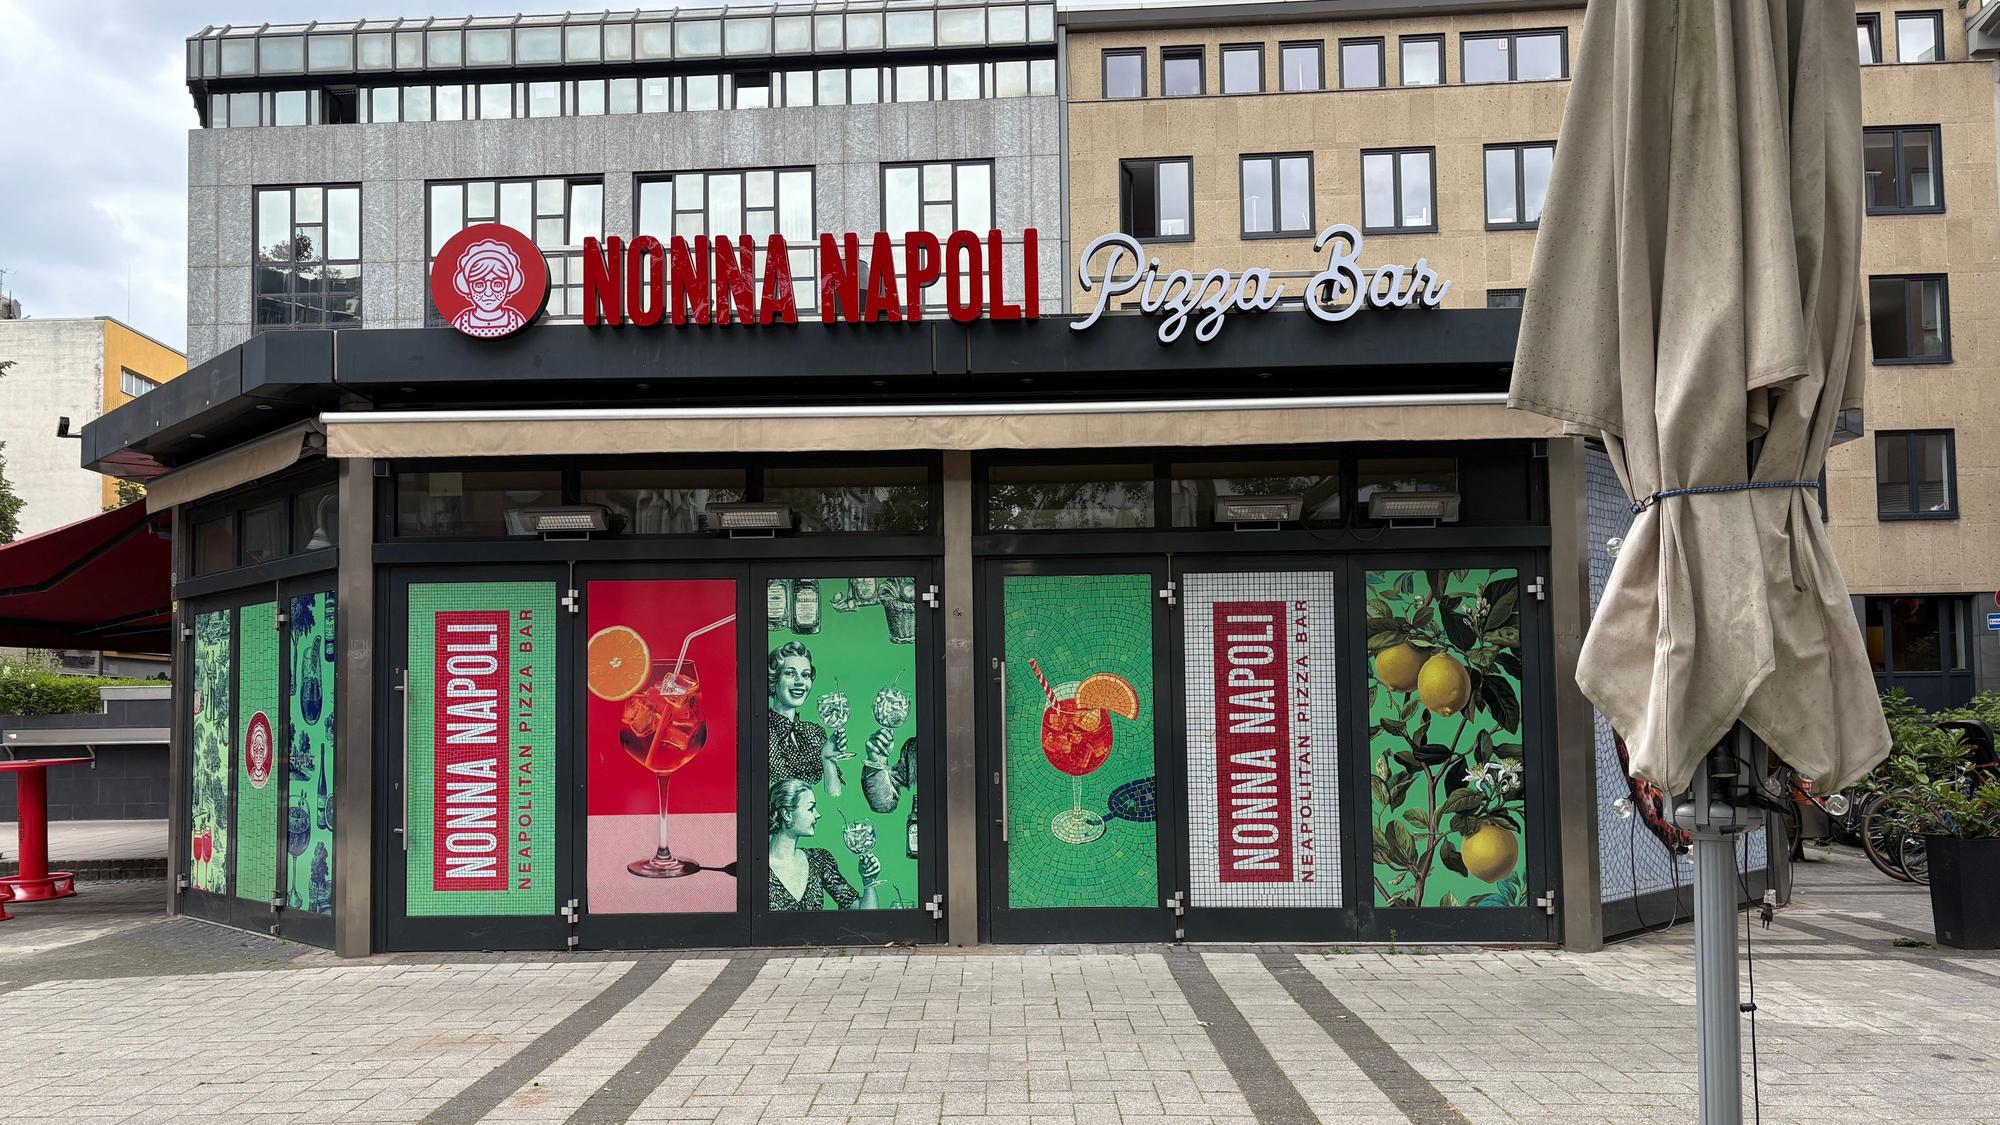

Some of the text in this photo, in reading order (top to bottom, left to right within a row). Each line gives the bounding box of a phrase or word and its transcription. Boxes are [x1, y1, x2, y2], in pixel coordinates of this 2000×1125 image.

[583, 228, 1039, 328] NONNA NAPOLI
[1070, 224, 1452, 344] Pizza Bar
[446, 624, 498, 878] NONNA NAPOLI
[518, 609, 534, 890] NEAPOLITAN PIZZA BAR
[1226, 615, 1280, 870] NONNA NAPOLI
[1295, 600, 1315, 882] NEAPOLITAN PIZZA BAR
